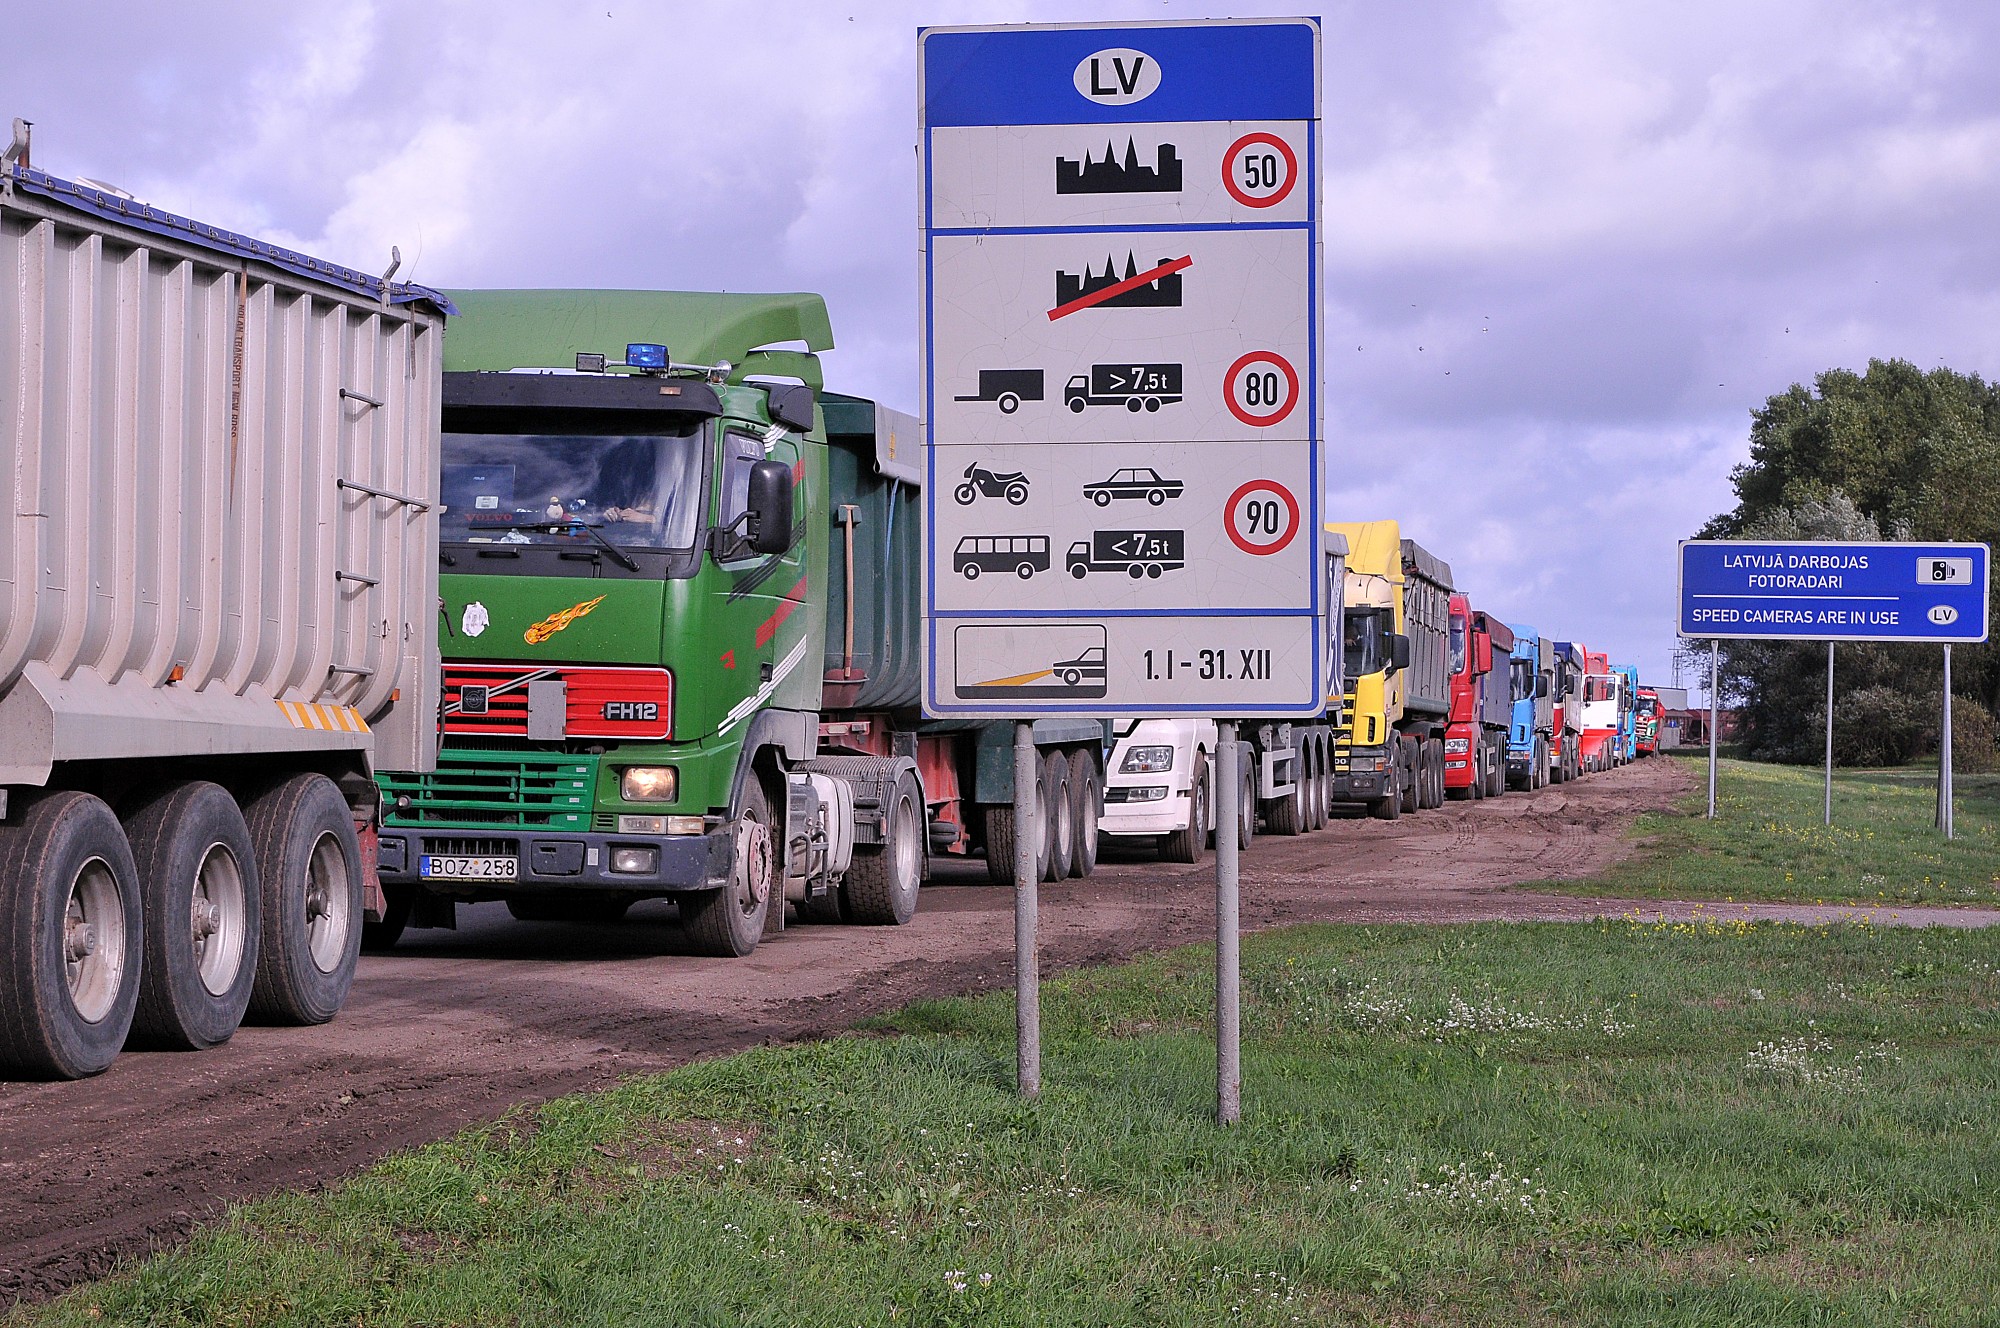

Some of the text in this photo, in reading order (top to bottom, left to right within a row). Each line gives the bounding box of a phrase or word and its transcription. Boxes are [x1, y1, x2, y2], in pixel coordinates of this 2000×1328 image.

[1090, 56, 1144, 95] LV
[1245, 154, 1277, 188] 50
[235, 305, 245, 332] NOLAN
[232, 336, 242, 388] TRANSPORT
[1246, 372, 1278, 406] 80
[464, 513, 513, 522] VOLVO
[1247, 500, 1279, 535] 90
[1724, 553, 1869, 569] LATVIJĀ DARBOJAS
[1748, 574, 1843, 589] FOTORADARI
[1692, 608, 1899, 625] SPEED CAMERAS ARE IN USE
[1933, 609, 1952, 621] LV
[606, 702, 657, 720] FH12
[431, 858, 515, 877] BOZ 258
